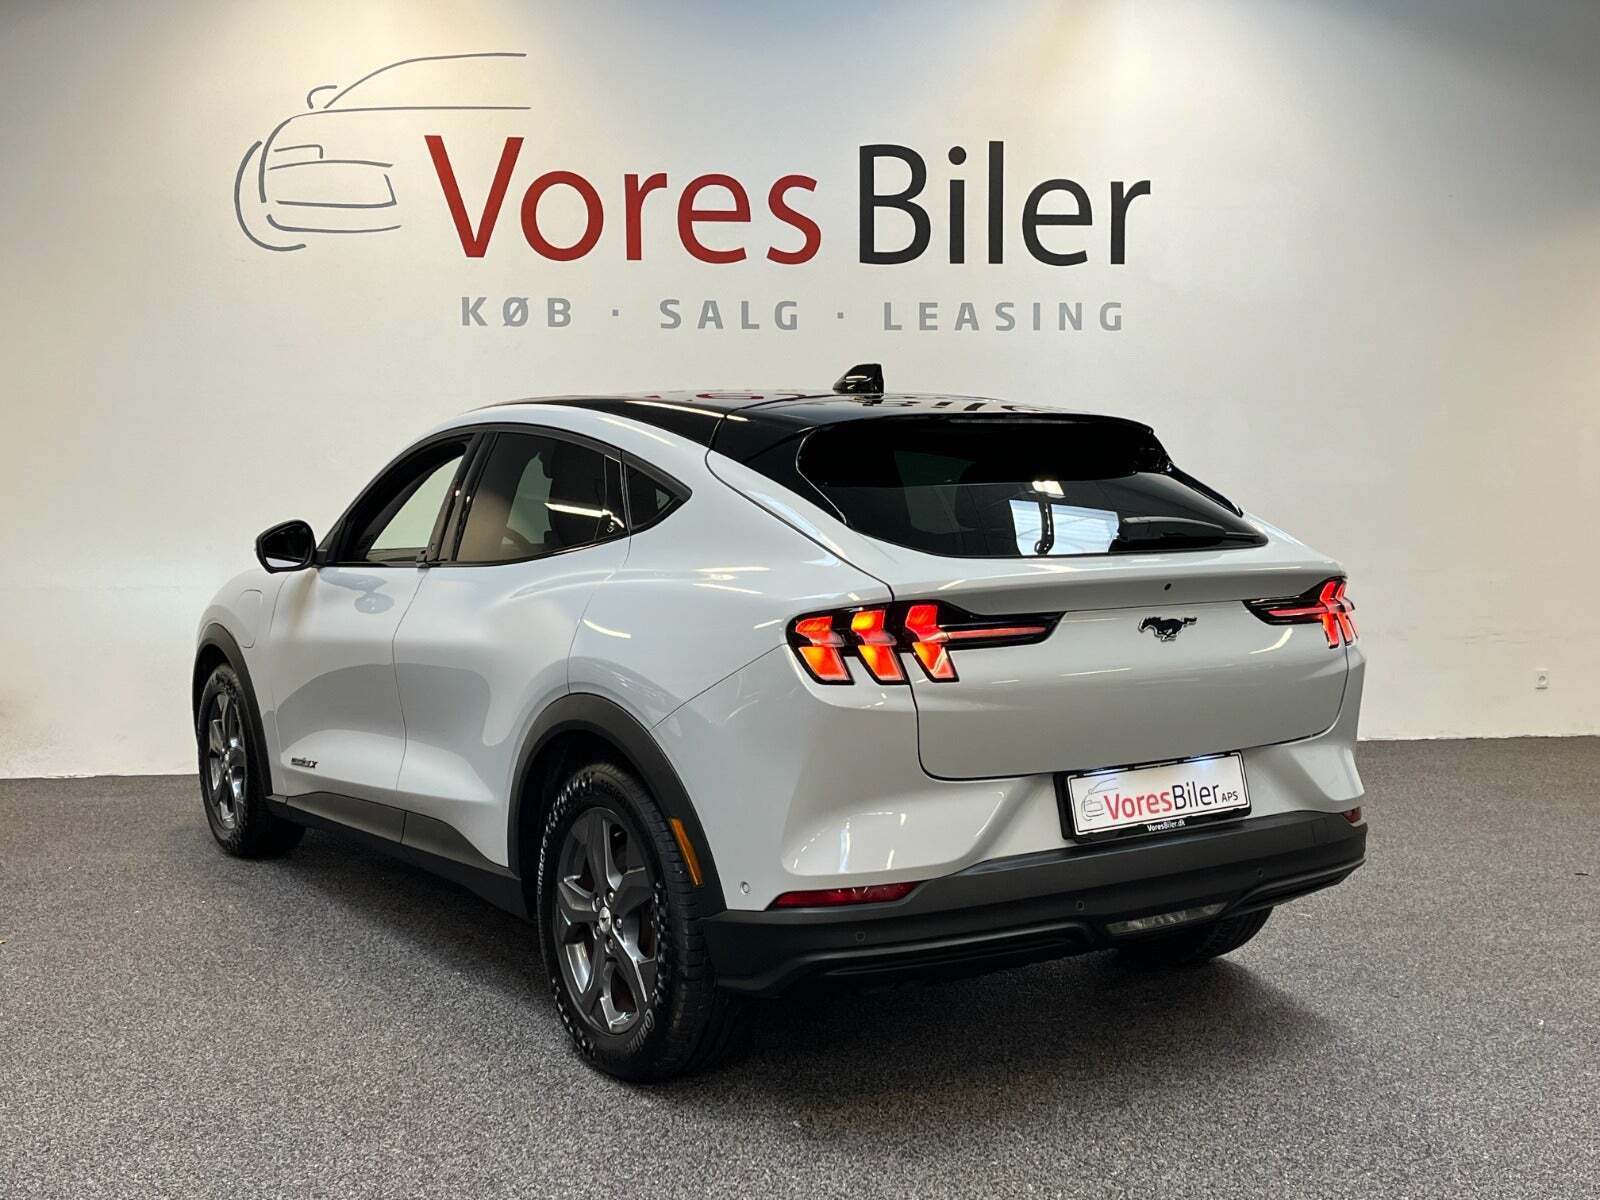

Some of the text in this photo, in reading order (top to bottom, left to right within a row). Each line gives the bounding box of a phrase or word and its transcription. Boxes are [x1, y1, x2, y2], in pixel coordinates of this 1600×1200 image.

[425, 135, 1151, 267] Vores Biler
[461, 296, 1124, 332] KØB SALG LEASING
[1221, 791, 1239, 803] APS
[1147, 819, 1186, 832] VoresBiler.dk
